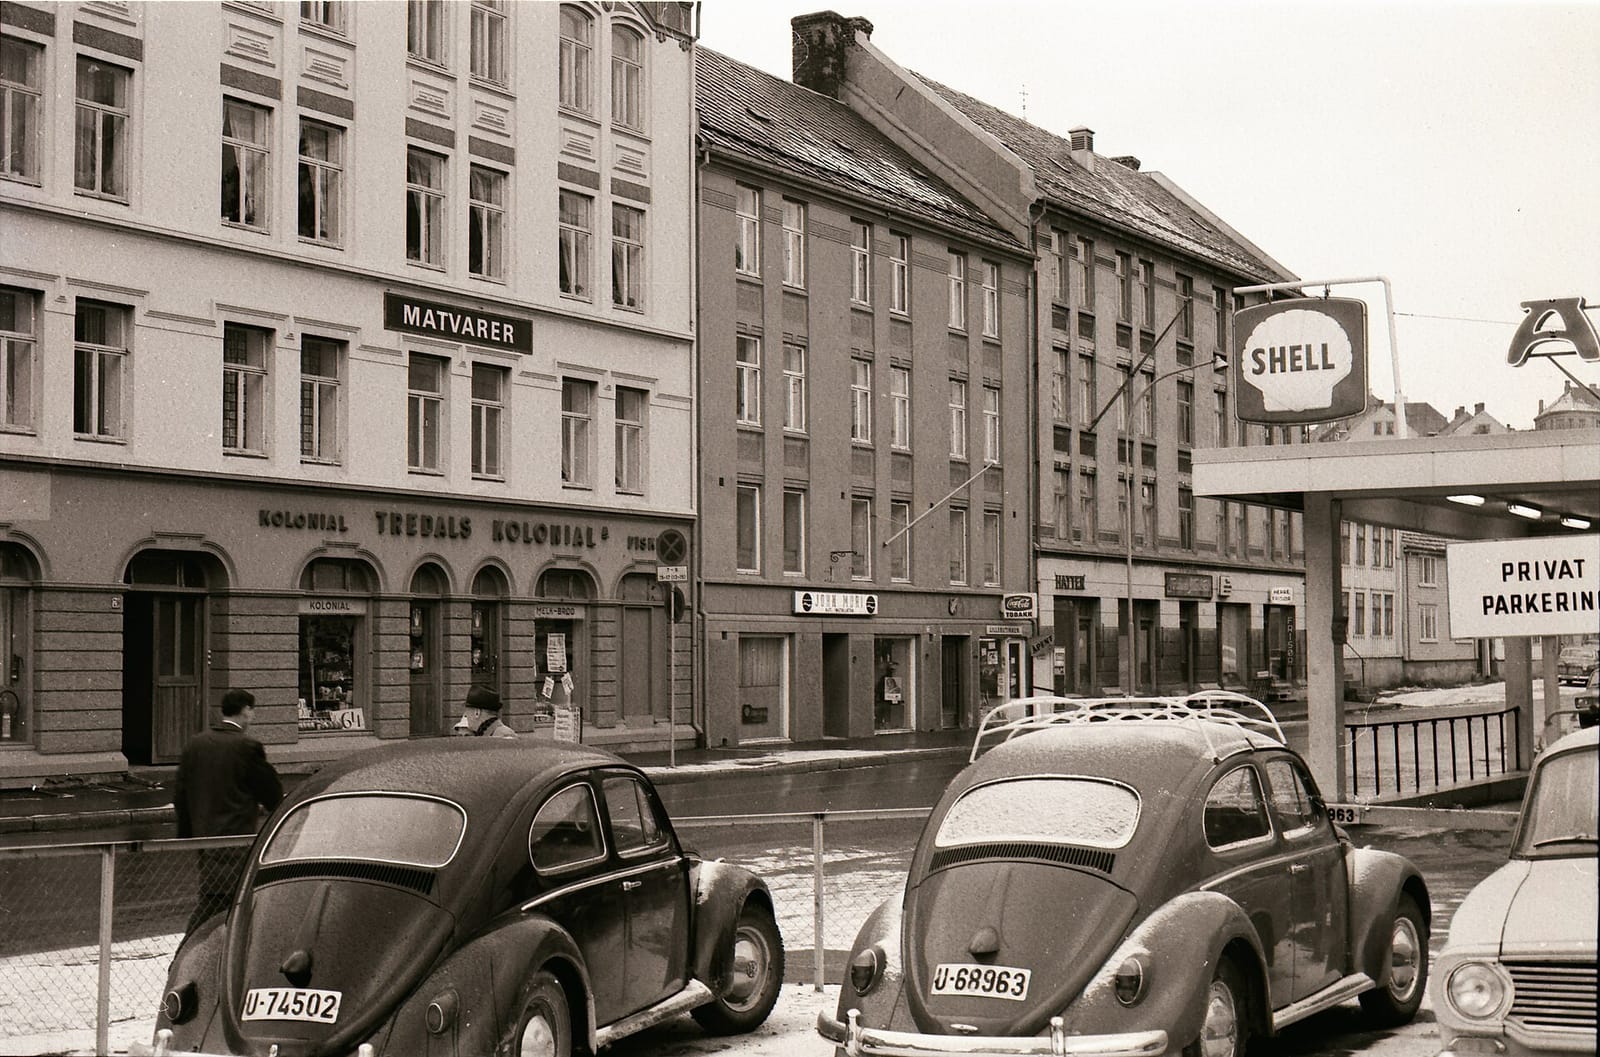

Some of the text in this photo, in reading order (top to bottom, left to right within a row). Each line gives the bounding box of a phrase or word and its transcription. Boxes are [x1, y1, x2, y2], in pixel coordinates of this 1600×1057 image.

[403, 303, 515, 344] MATVARER
[1251, 343, 1336, 376] SHELL
[258, 510, 349, 532] KOLONIAL
[375, 511, 472, 539] TREDALS
[492, 519, 596, 548] KOLONIAL
[1502, 558, 1585, 582] PRIVAT
[309, 600, 351, 610] KOLONIAL
[1482, 590, 1600, 615] PARKERIN
[934, 967, 1026, 996] U-68963
[245, 991, 338, 1019] U-74502
